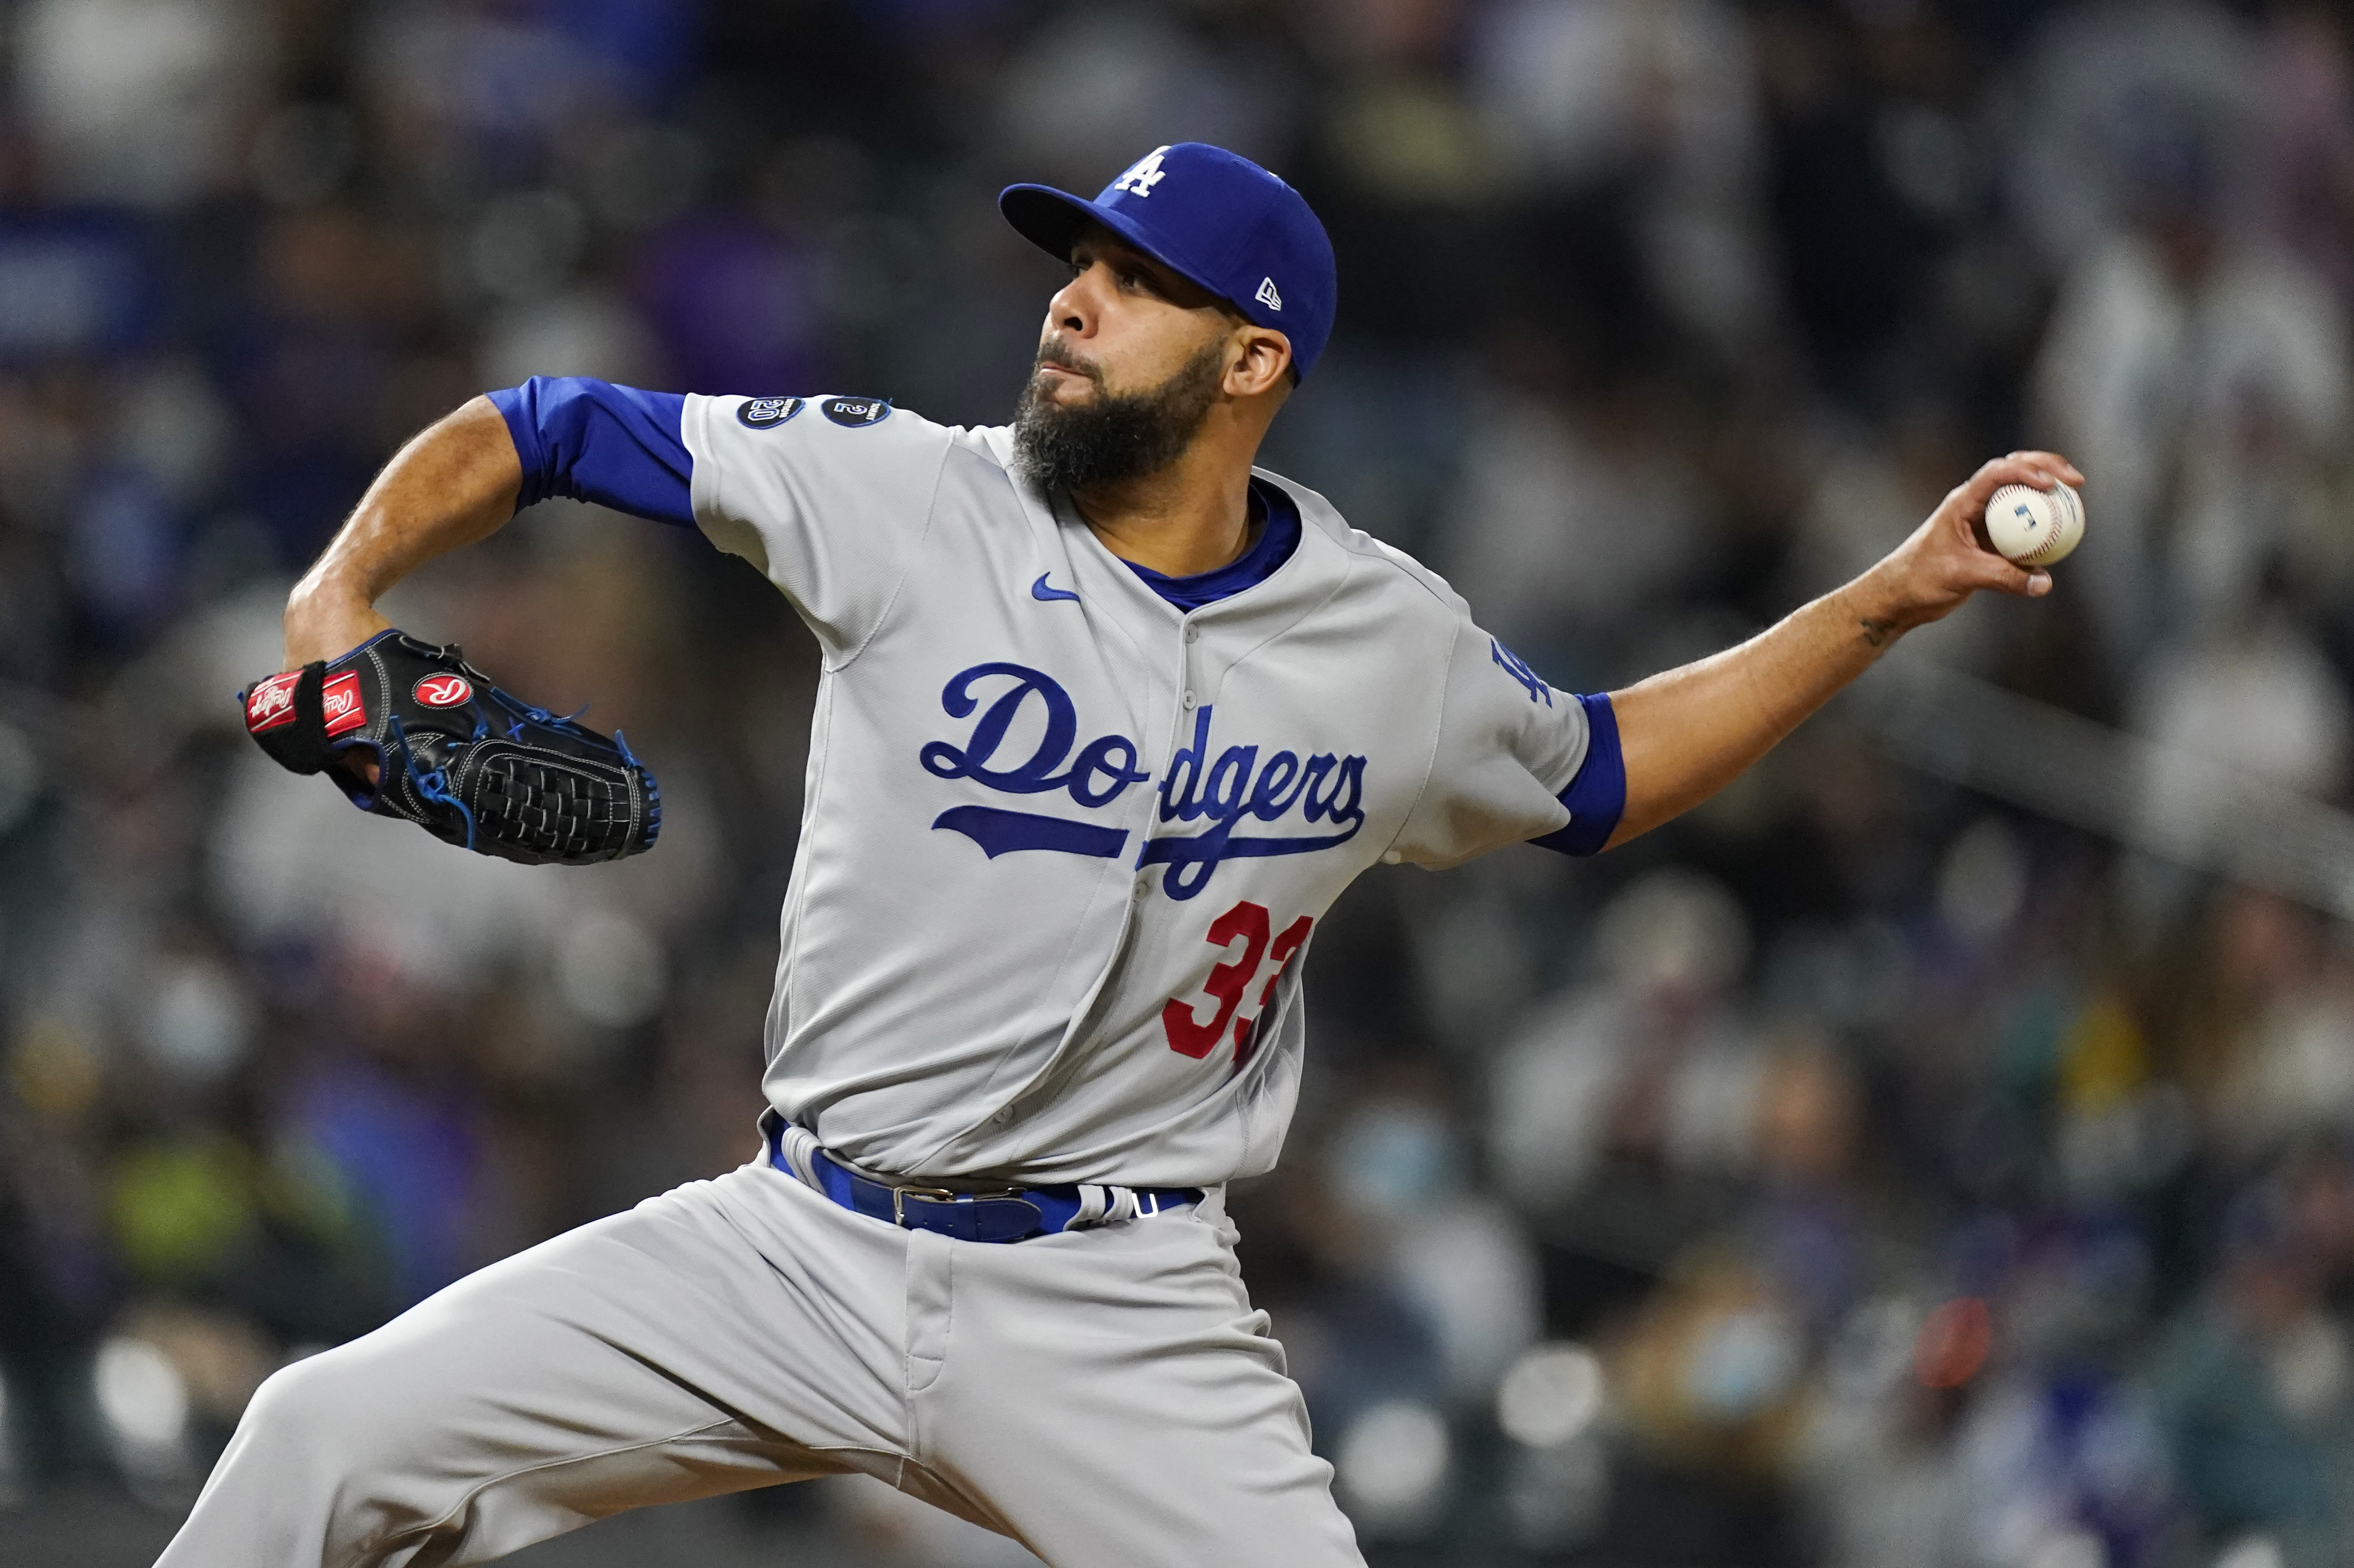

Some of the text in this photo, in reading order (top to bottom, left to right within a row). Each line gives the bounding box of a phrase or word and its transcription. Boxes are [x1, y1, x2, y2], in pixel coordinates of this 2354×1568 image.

[1114, 145, 1172, 197] LA
[747, 399, 784, 421] 20
[779, 398, 795, 418] SUTTON
[833, 402, 867, 415] 2
[865, 403, 881, 421] TOMMY
[920, 662, 1367, 901] Dodgers
[1162, 900, 1313, 1064] 33
